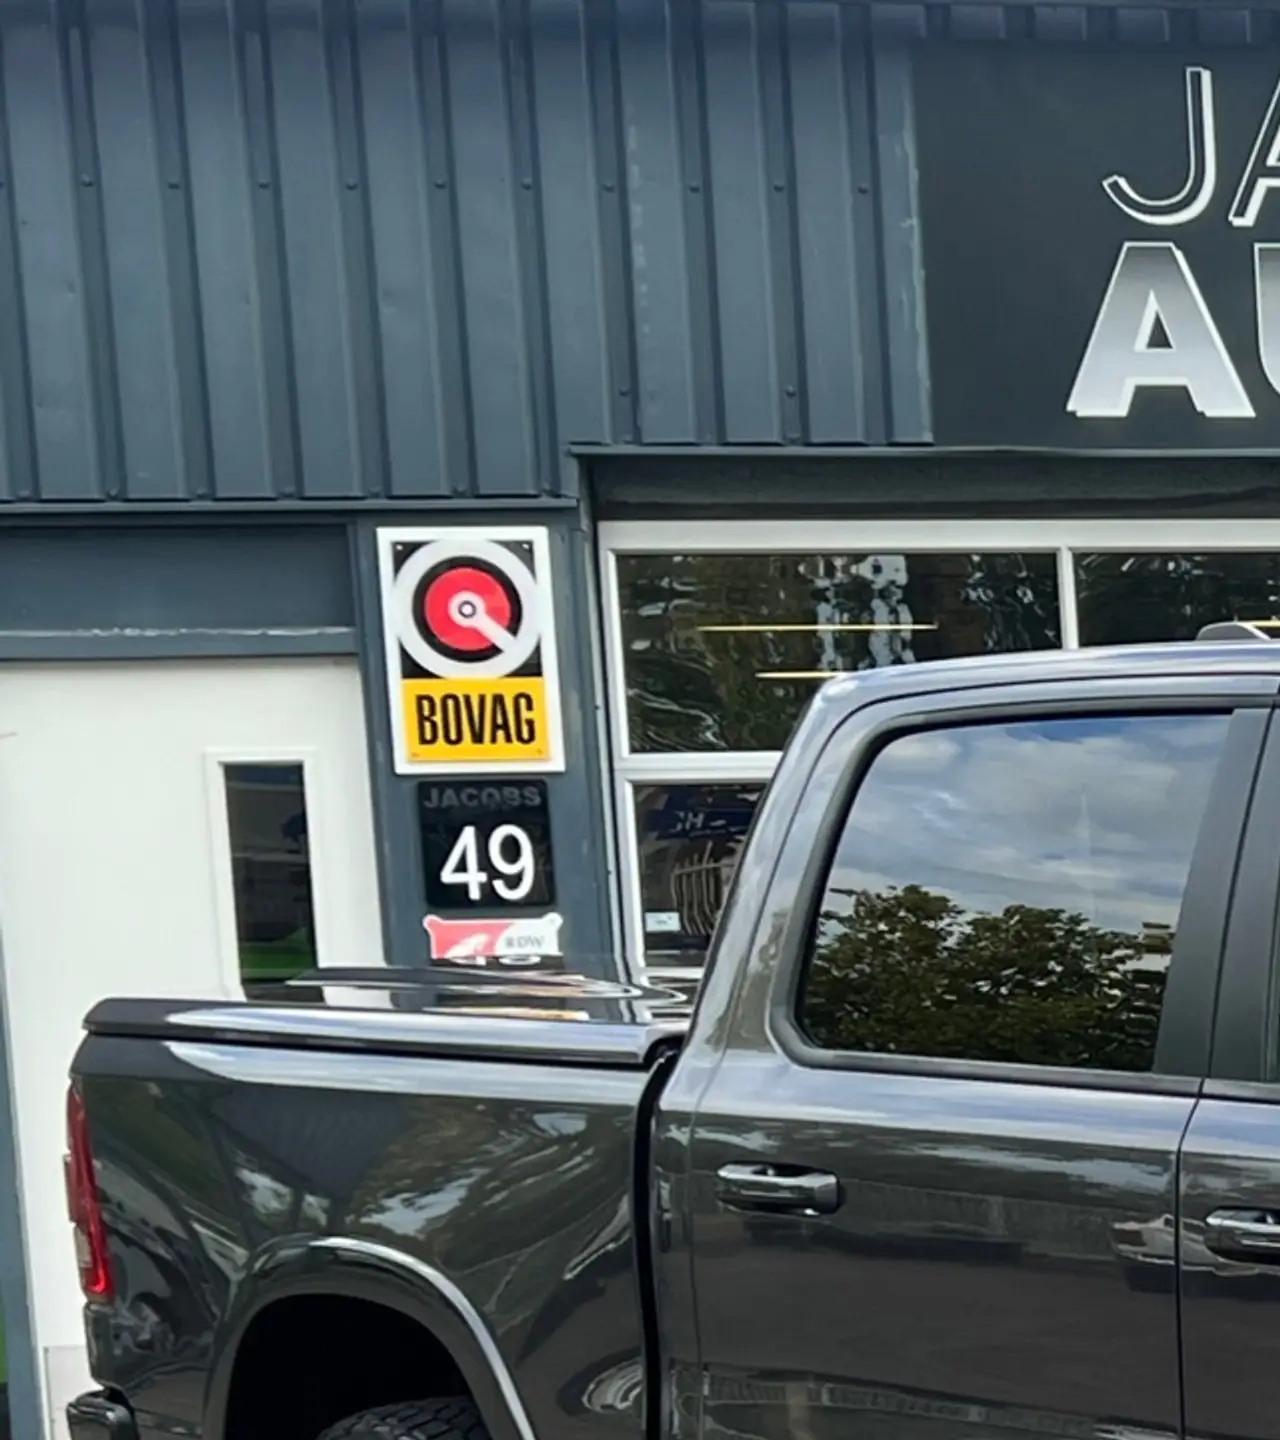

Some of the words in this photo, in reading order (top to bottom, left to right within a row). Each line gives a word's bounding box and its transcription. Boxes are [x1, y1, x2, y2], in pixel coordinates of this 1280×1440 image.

[415, 691, 536, 747] BOVAG
[423, 785, 542, 809] JACOBS
[440, 823, 536, 902] 49
